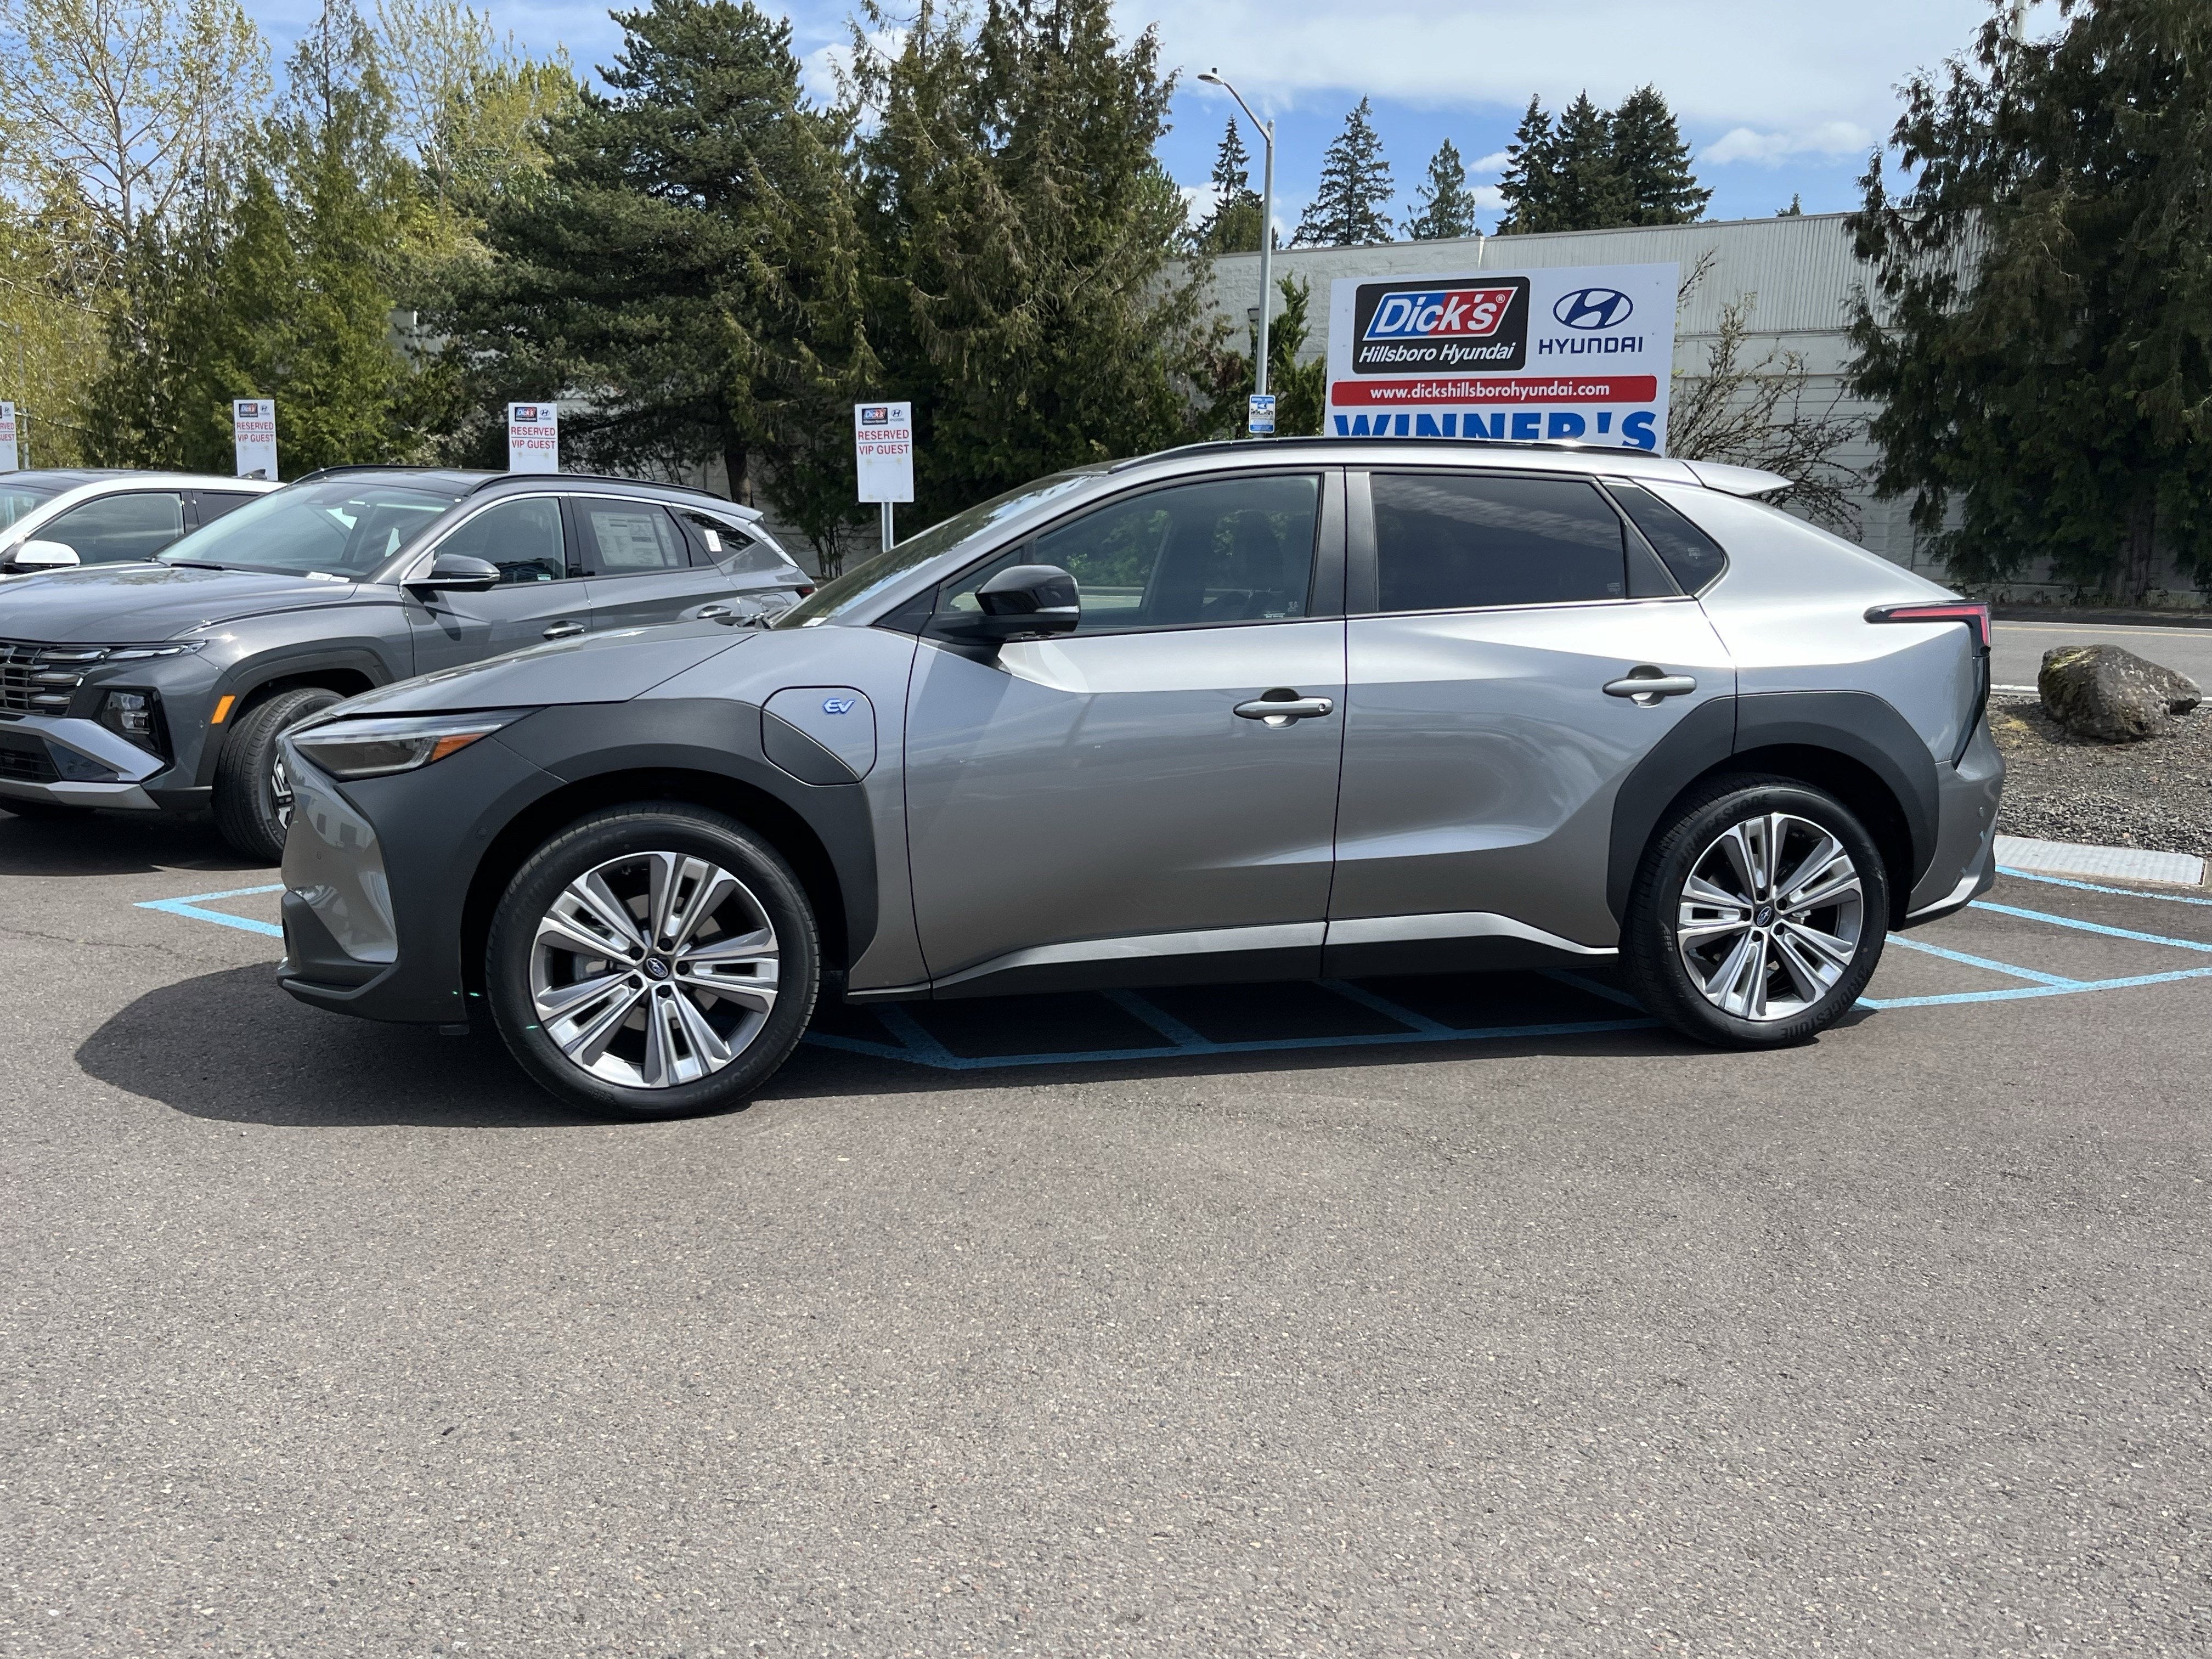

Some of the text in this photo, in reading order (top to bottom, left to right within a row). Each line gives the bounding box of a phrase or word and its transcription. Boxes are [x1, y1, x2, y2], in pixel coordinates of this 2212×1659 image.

[1374, 294, 1497, 333] Dick's
[1539, 336, 1643, 354] HYUNDAI
[1358, 342, 1516, 364] Hillsboro Hyundai
[1370, 381, 1610, 400] www.dickshillsborohyundai.com
[236, 422, 274, 430] RESERVED
[511, 427, 556, 436] RESERVED
[238, 434, 274, 442] VIP GUEST
[858, 430, 910, 441] RESERVED
[512, 440, 556, 449] VIP GUEST
[859, 444, 910, 455] VIP GUEST
[823, 698, 856, 714] EV
